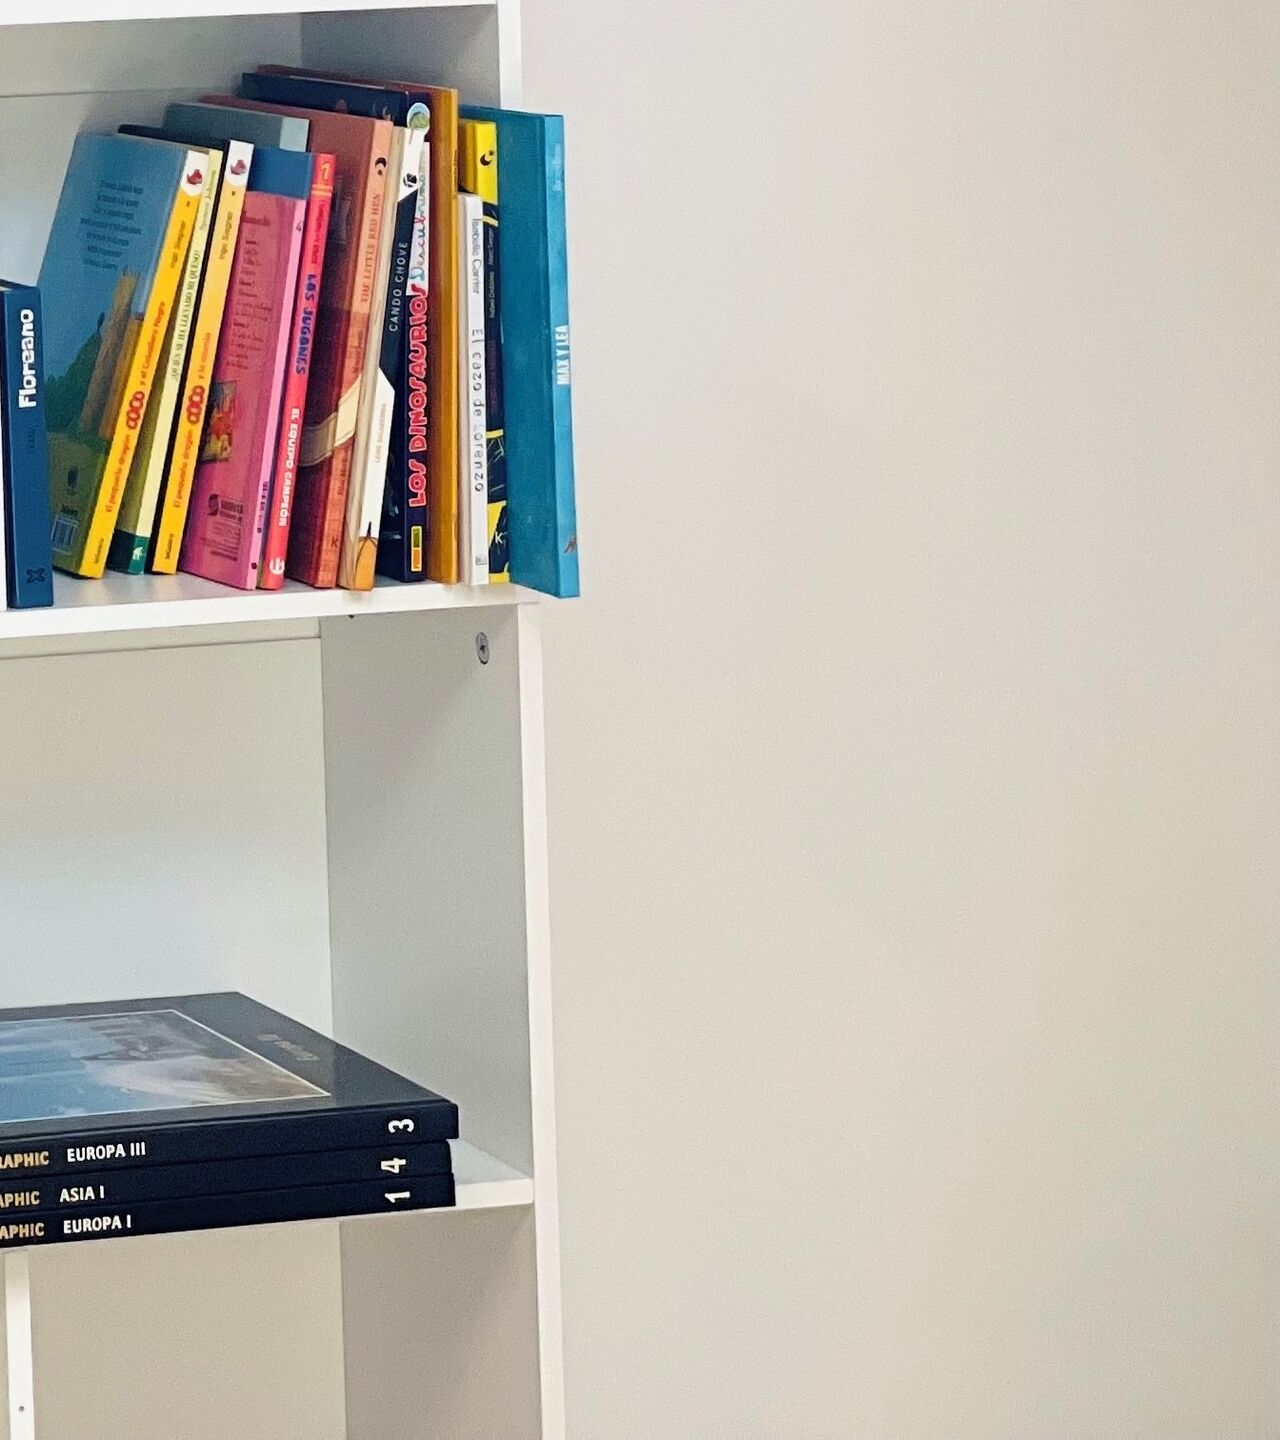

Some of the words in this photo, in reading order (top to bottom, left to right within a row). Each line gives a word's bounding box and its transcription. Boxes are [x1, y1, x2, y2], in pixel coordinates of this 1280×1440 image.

[368, 221, 378, 240] RED
[363, 246, 374, 282] LITTLE
[304, 273, 319, 302] LOS
[389, 288, 403, 332] CANDO
[295, 307, 314, 375] JUGONES
[471, 328, 484, 344] El
[555, 324, 569, 346] LEA
[18, 308, 37, 409] Floreano
[556, 347, 569, 357] Y
[408, 283, 428, 453] DINOSAURIOS
[472, 352, 483, 391] cazo
[556, 357, 570, 385] MAX
[291, 408, 301, 420] EL
[473, 401, 485, 417] de
[285, 423, 299, 469] EQUIPO
[409, 459, 427, 508] LOS
[278, 472, 293, 527] CAMPEÓN
[387, 1118, 415, 1134] 3
[66, 1143, 127, 1163] EUROPA
[129, 1141, 147, 1157] III
[380, 1157, 407, 1174] 4
[59, 1187, 96, 1203] ASIA
[99, 1185, 106, 1200] I
[384, 1190, 411, 1204] 1
[62, 1216, 123, 1235] EUROPA
[125, 1214, 133, 1229] I
